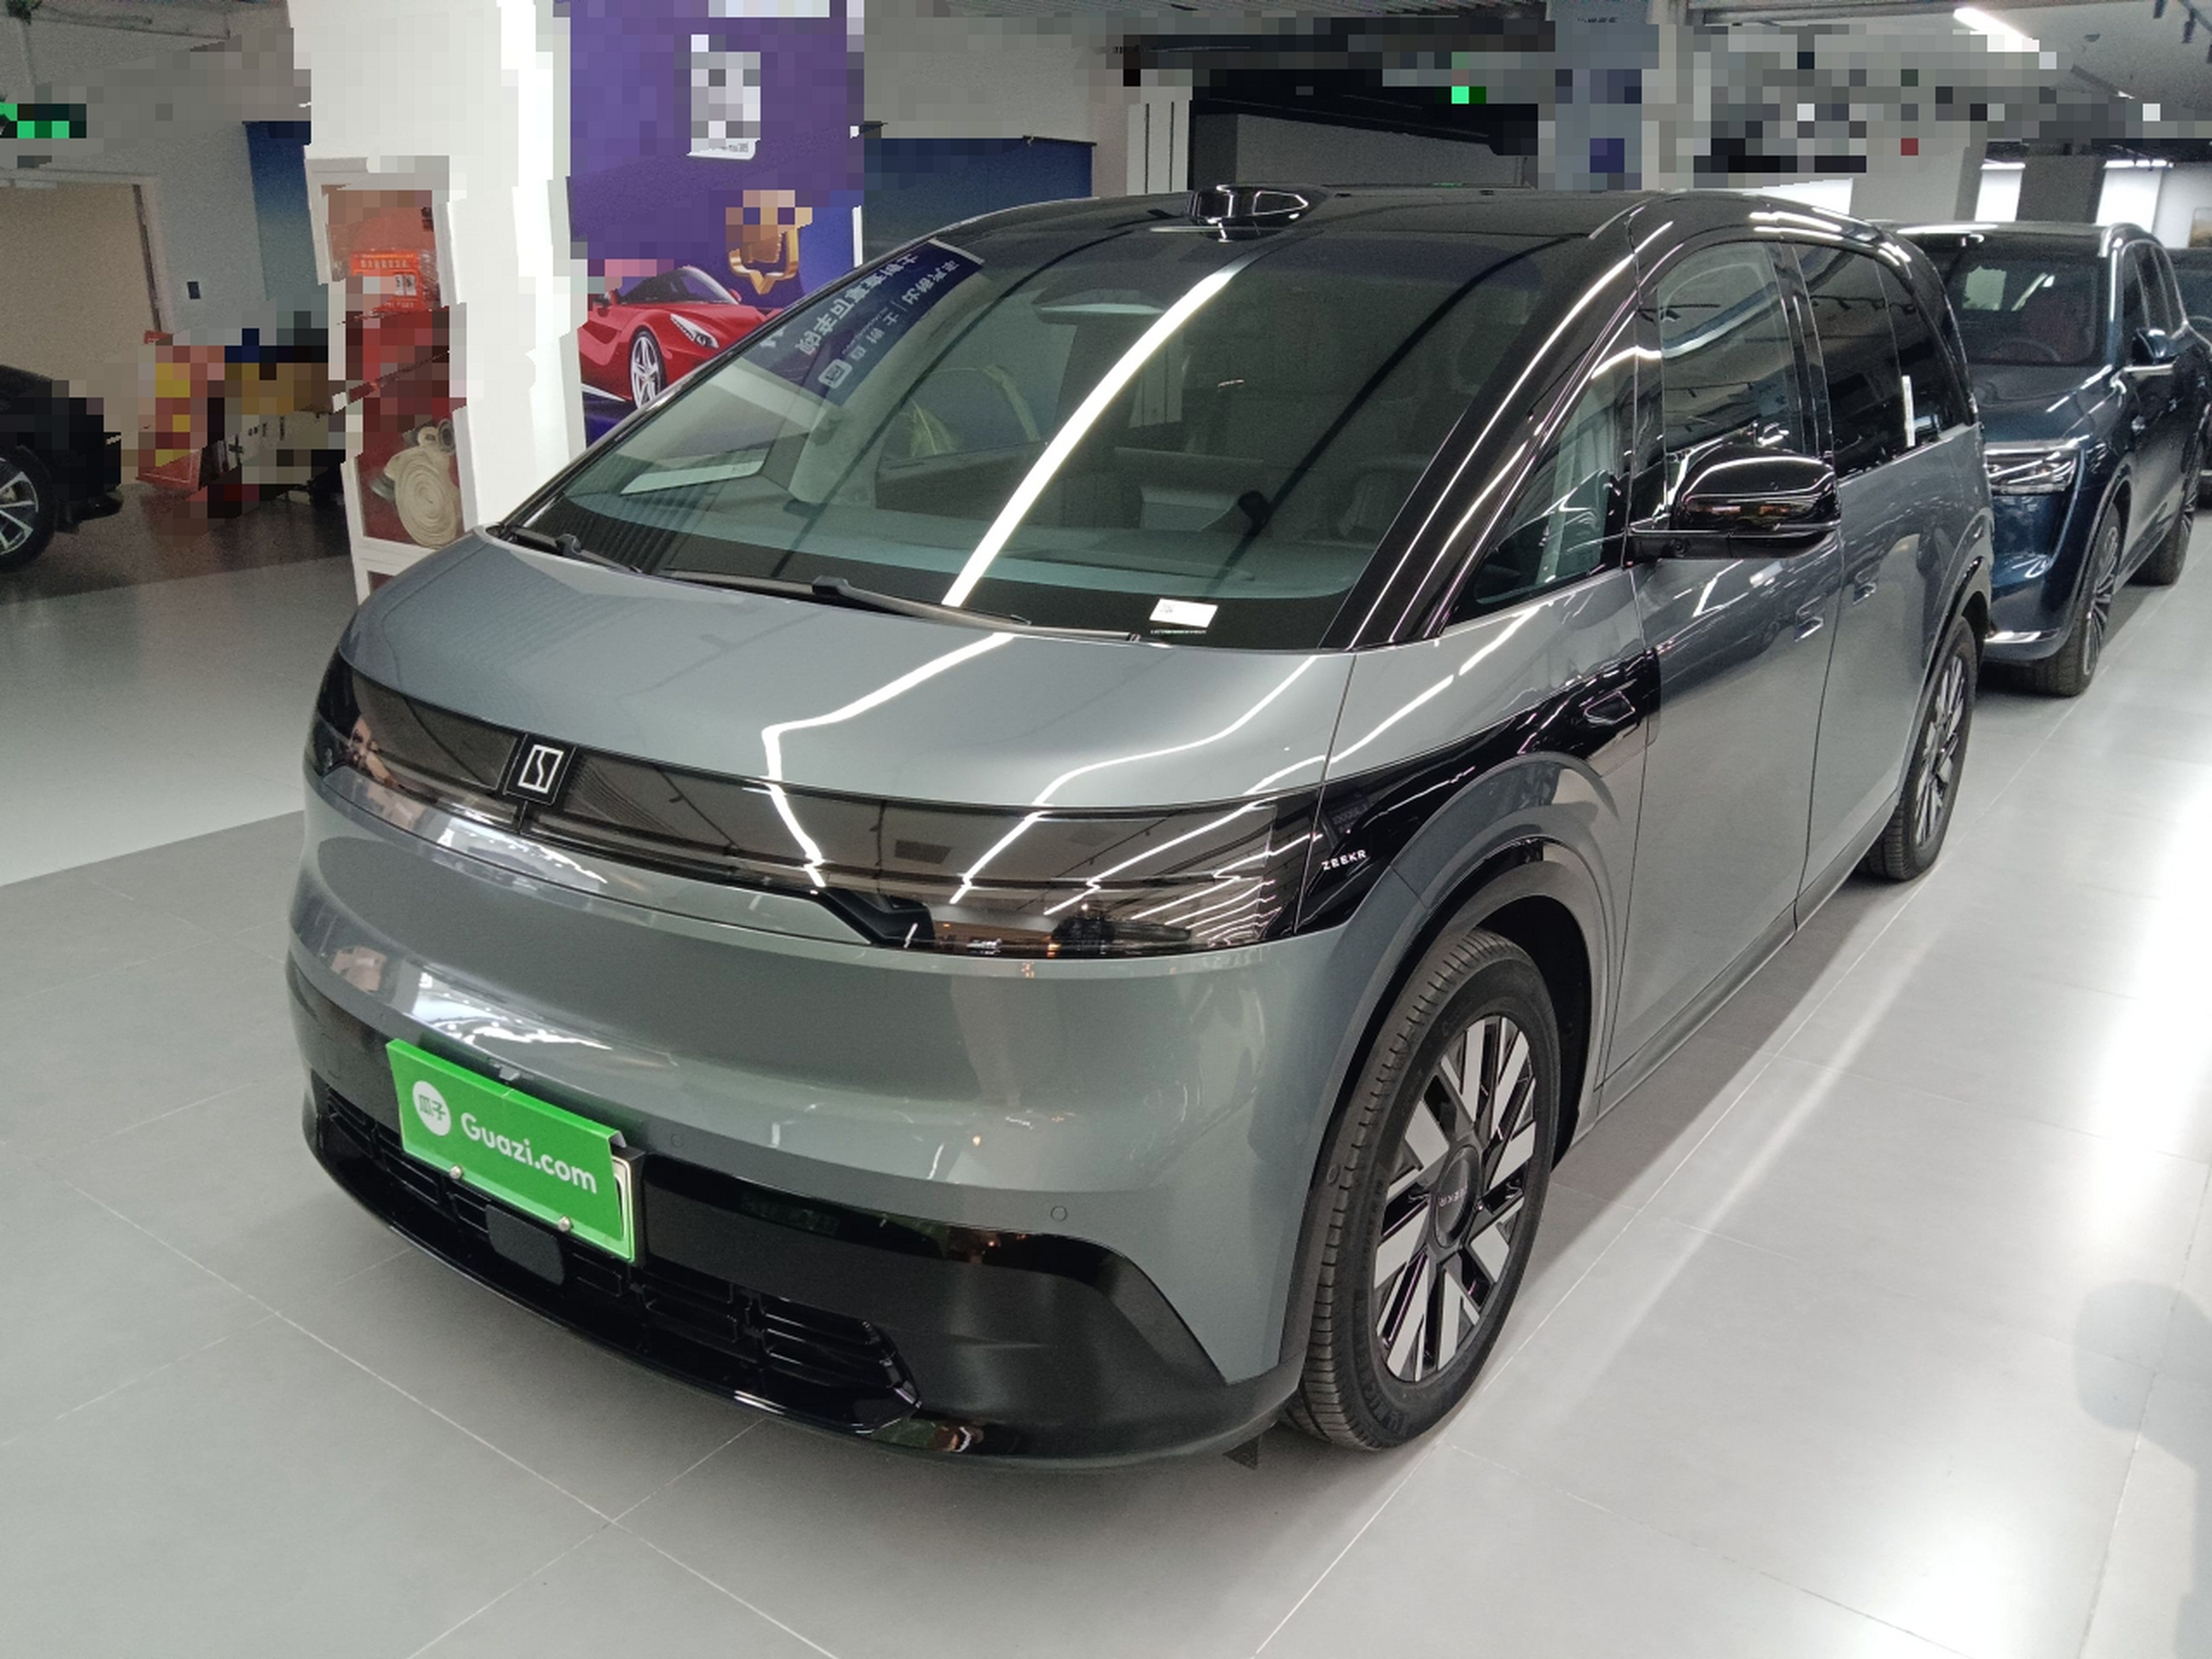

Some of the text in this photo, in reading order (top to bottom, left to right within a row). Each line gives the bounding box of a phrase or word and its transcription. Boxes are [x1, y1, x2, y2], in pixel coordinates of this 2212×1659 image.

[1321, 850, 1366, 871] ZEEKR
[418, 1094, 446, 1121] 瓜子
[461, 1112, 597, 1194] Guazi.com
